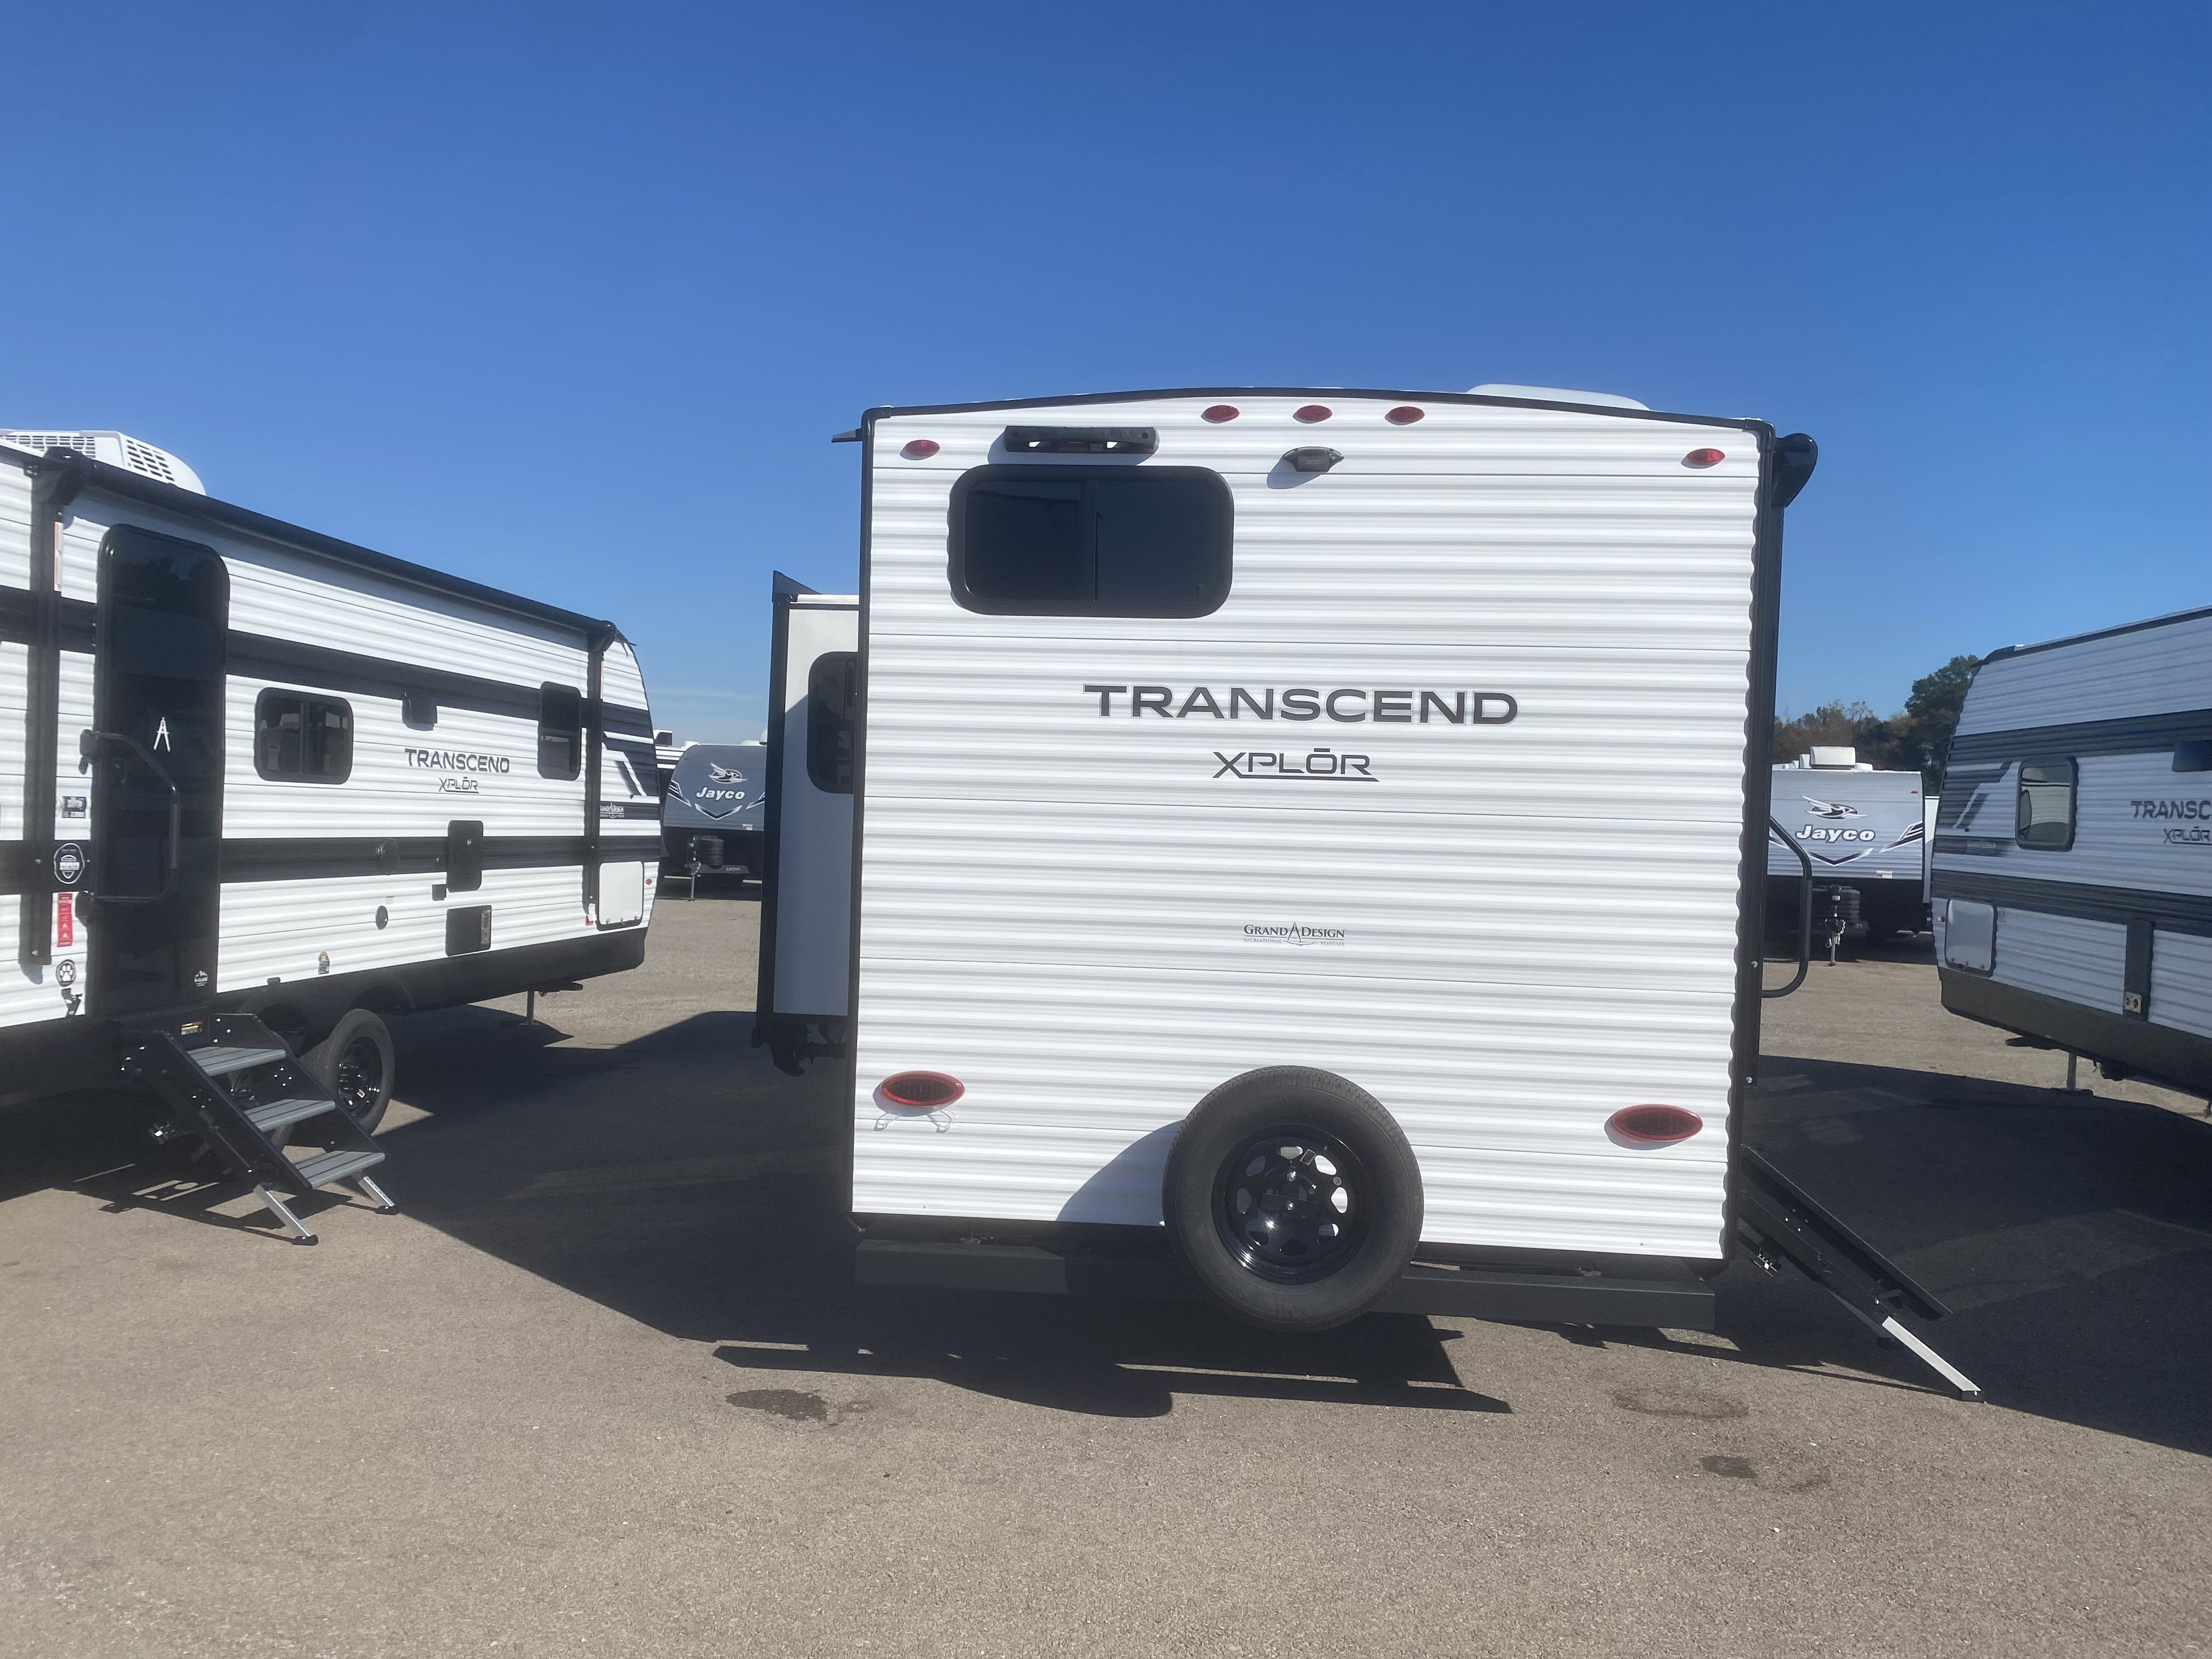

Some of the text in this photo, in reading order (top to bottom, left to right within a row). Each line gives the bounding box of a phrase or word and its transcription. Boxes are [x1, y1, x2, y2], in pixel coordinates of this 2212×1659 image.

[1084, 685, 1518, 725] TRANSCEND
[404, 748, 510, 773] TRANSCEND
[696, 786, 746, 801] Jayco
[2131, 800, 2212, 820] TRANSC
[1795, 825, 1876, 843] Jayco
[1244, 924, 1345, 938] GRAND DESIGN
